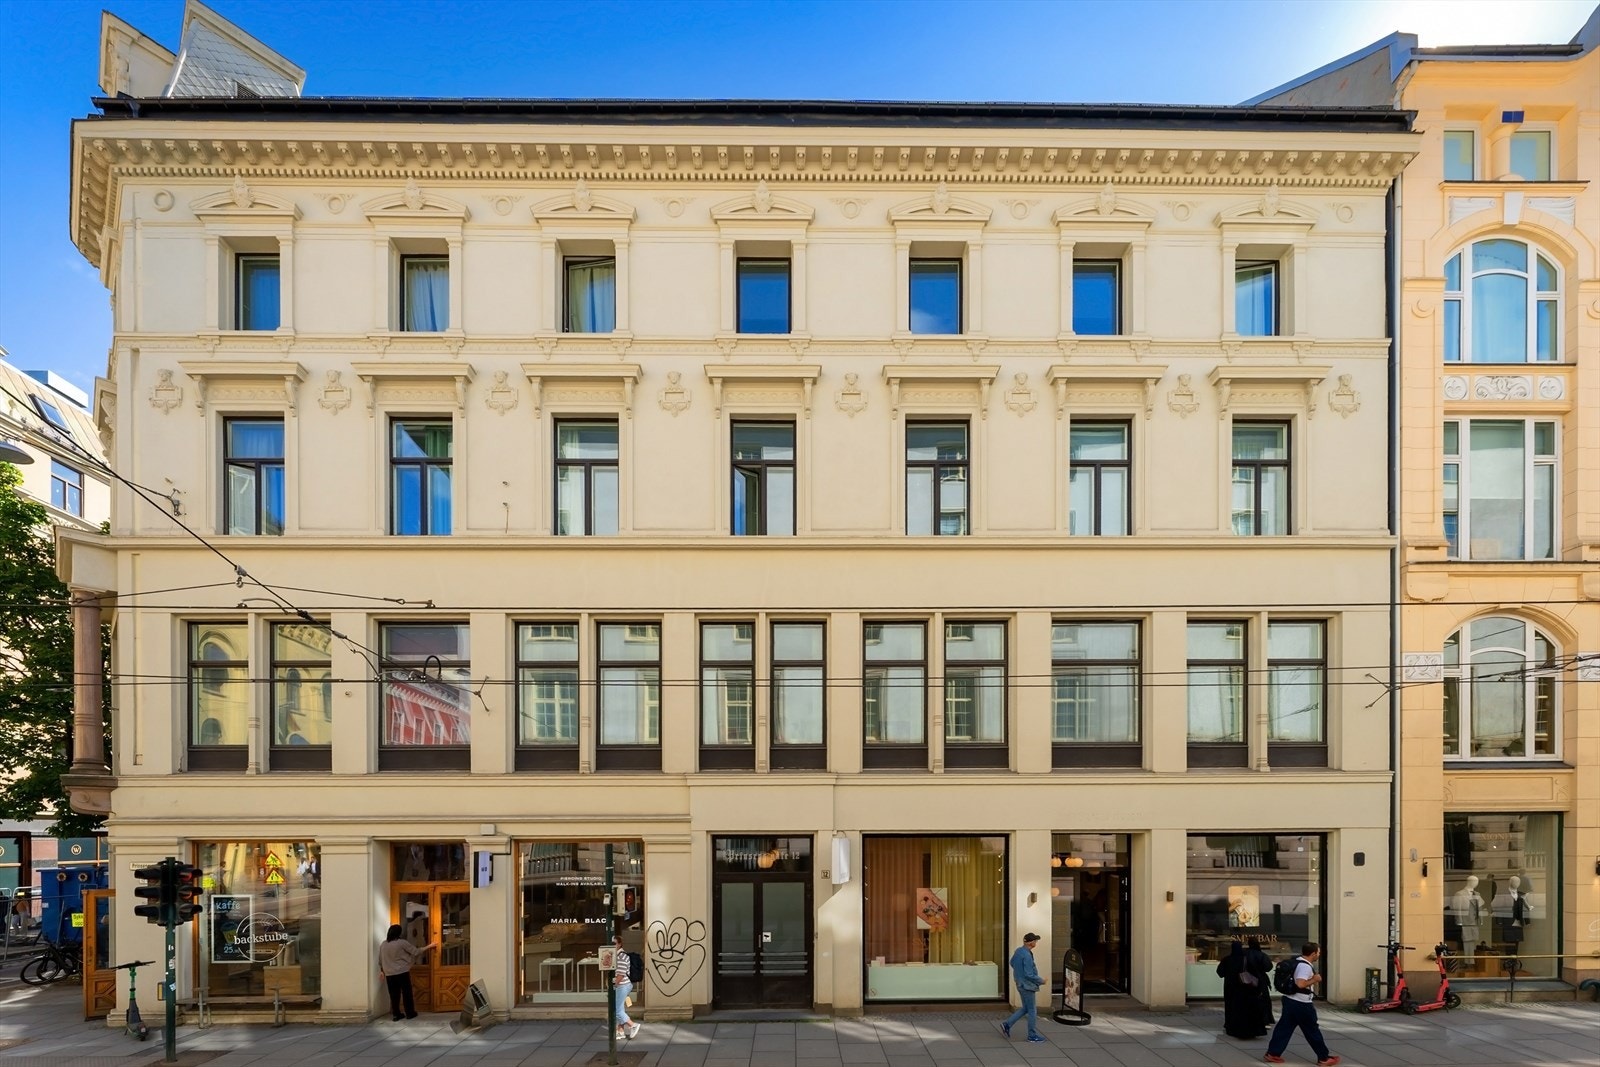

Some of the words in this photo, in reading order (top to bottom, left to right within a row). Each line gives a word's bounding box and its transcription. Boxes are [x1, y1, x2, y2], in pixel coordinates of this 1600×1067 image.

[792, 851, 800, 860] 12
[233, 931, 288, 945] backstube
[1230, 934, 1278, 943] SMBAR
